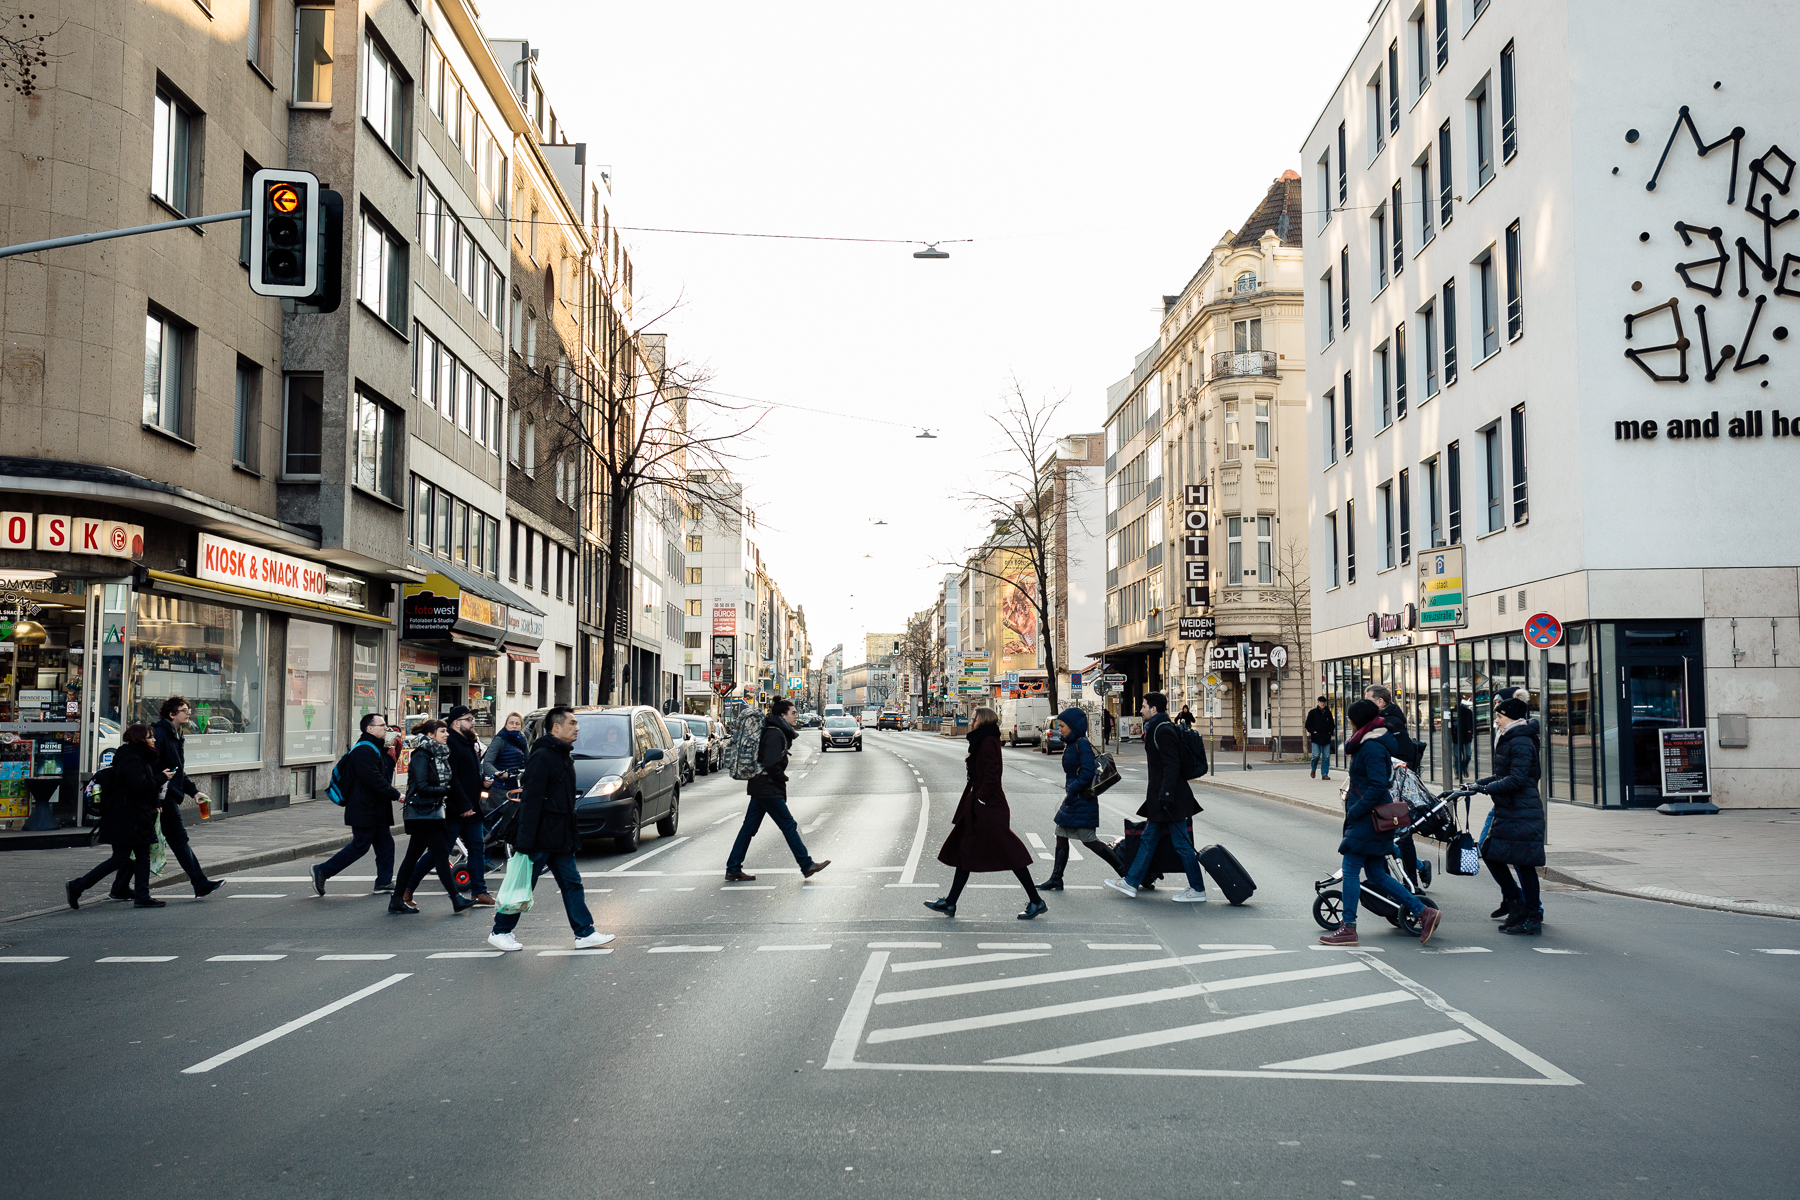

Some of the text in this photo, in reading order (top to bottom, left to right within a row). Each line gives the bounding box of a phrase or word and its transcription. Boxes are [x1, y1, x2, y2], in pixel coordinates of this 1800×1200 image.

[1615, 419, 1658, 440] me
[1666, 411, 1719, 439] and
[1728, 410, 1762, 438] all
[1187, 486, 1206, 605] HOTEL
[205, 544, 246, 578] KIOSK
[249, 555, 258, 580] &
[261, 557, 299, 589] SNACK
[414, 605, 455, 615] fotowest
[714, 608, 735, 617] BÜROS
[1423, 611, 1452, 621] Kreuzstraße
[1180, 619, 1214, 628] WEIDEN-
[1189, 629, 1207, 638] HOF
